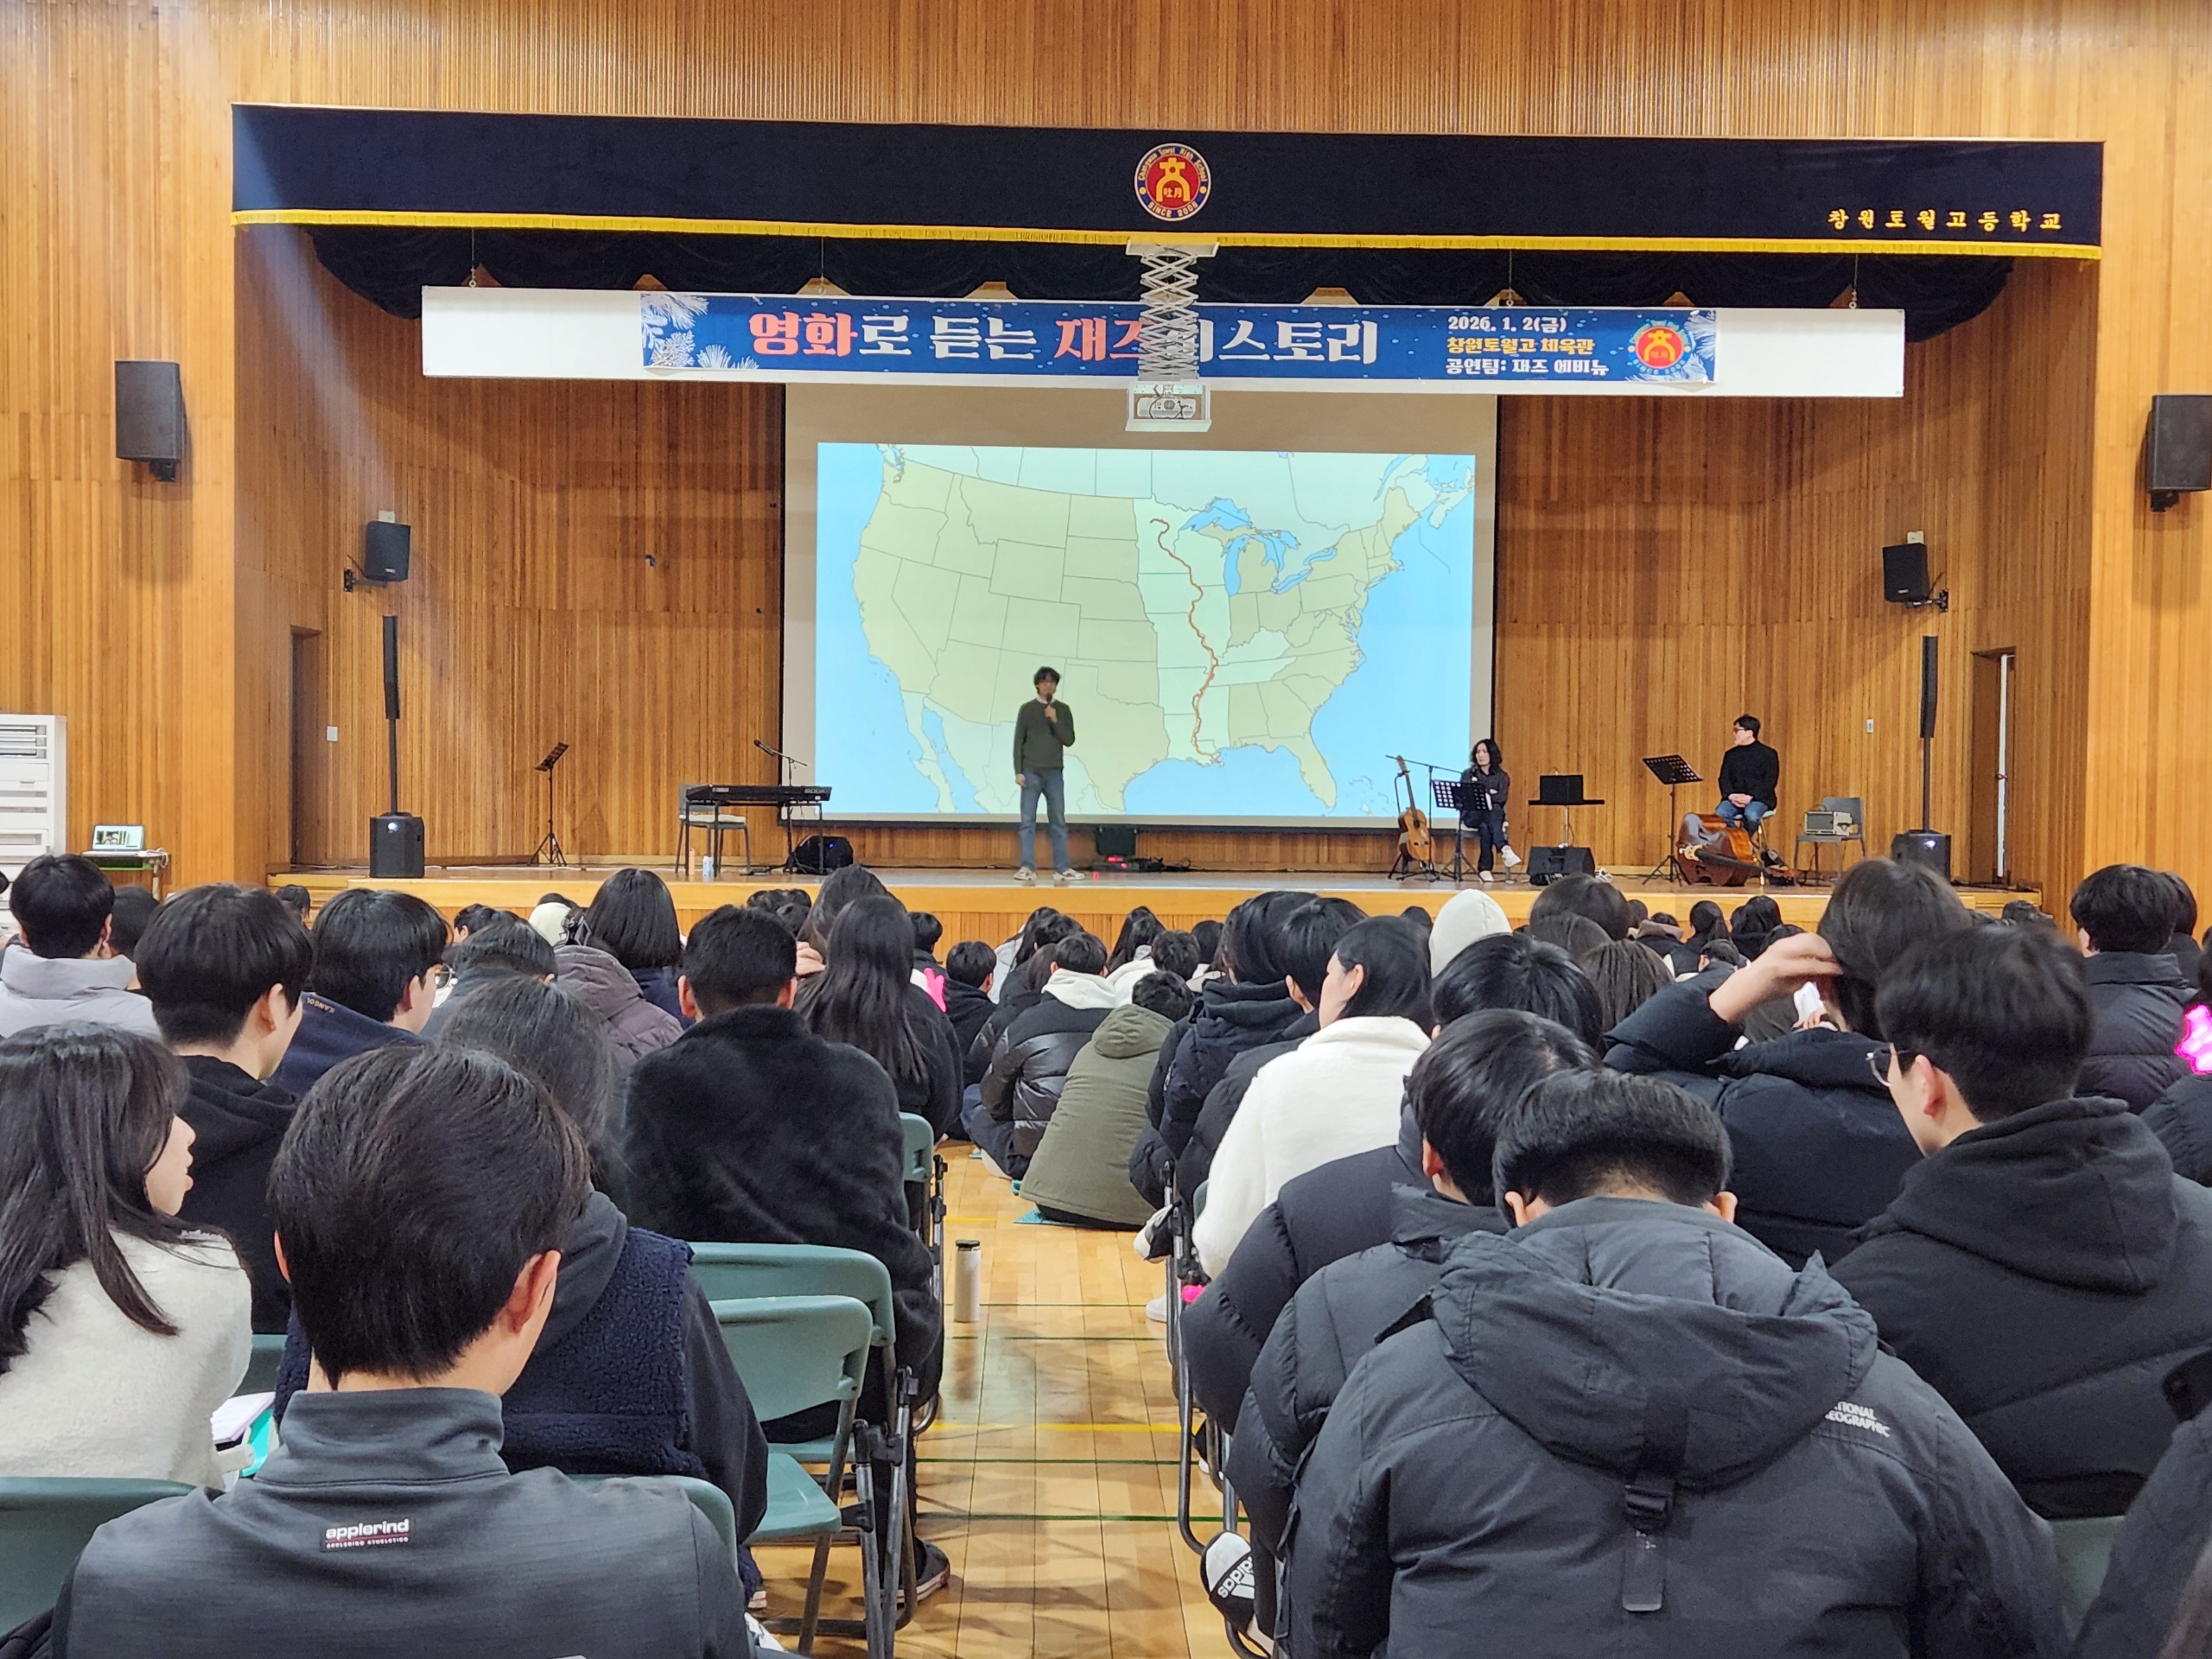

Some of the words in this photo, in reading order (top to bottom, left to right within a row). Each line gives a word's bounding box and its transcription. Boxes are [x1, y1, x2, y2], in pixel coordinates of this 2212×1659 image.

[1147, 200, 1173, 218] SINCE
[1827, 208, 2063, 232] 창원토월고등학교
[749, 311, 912, 358] 영화로
[929, 315, 1037, 359] 듣는
[1447, 315, 1497, 332] 2026.
[1502, 316, 1517, 333] 1.
[1522, 316, 1567, 334] 2(금)
[1446, 337, 1536, 354] 창원토월고
[1541, 338, 1596, 355] 체육관
[1446, 358, 1506, 375] 공연팀:
[1511, 359, 1549, 373] 재즈
[1554, 359, 1610, 376] 에비뉴
[1834, 1401, 1877, 1420] TIONAL
[1824, 1409, 1891, 1438] EOGRAPHIC
[325, 1518, 410, 1541] applerind
[1217, 1555, 1254, 1599] didas
